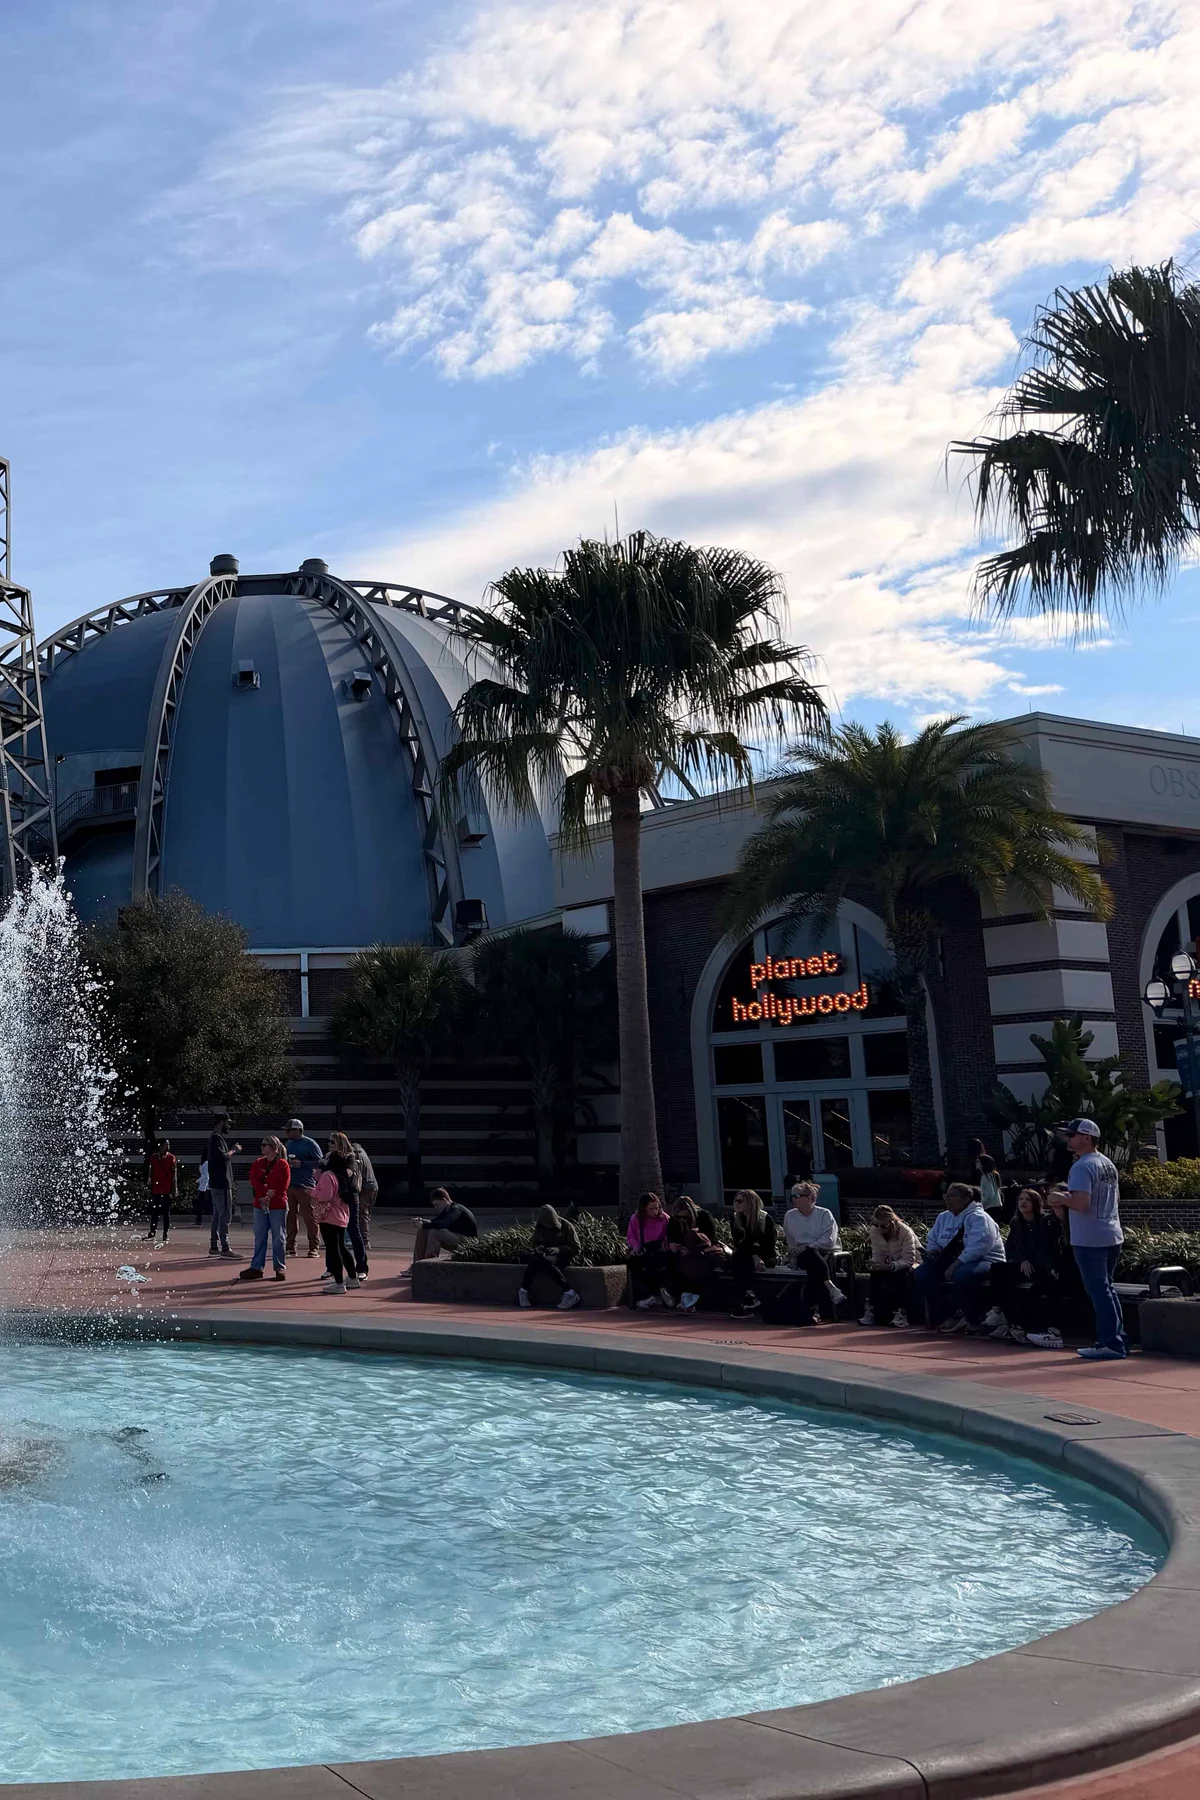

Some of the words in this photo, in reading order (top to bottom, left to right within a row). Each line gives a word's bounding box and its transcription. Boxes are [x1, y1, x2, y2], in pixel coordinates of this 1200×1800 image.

[1149, 764, 1200, 800] OBS
[751, 951, 838, 989] planet
[732, 982, 869, 1025] hollywood
